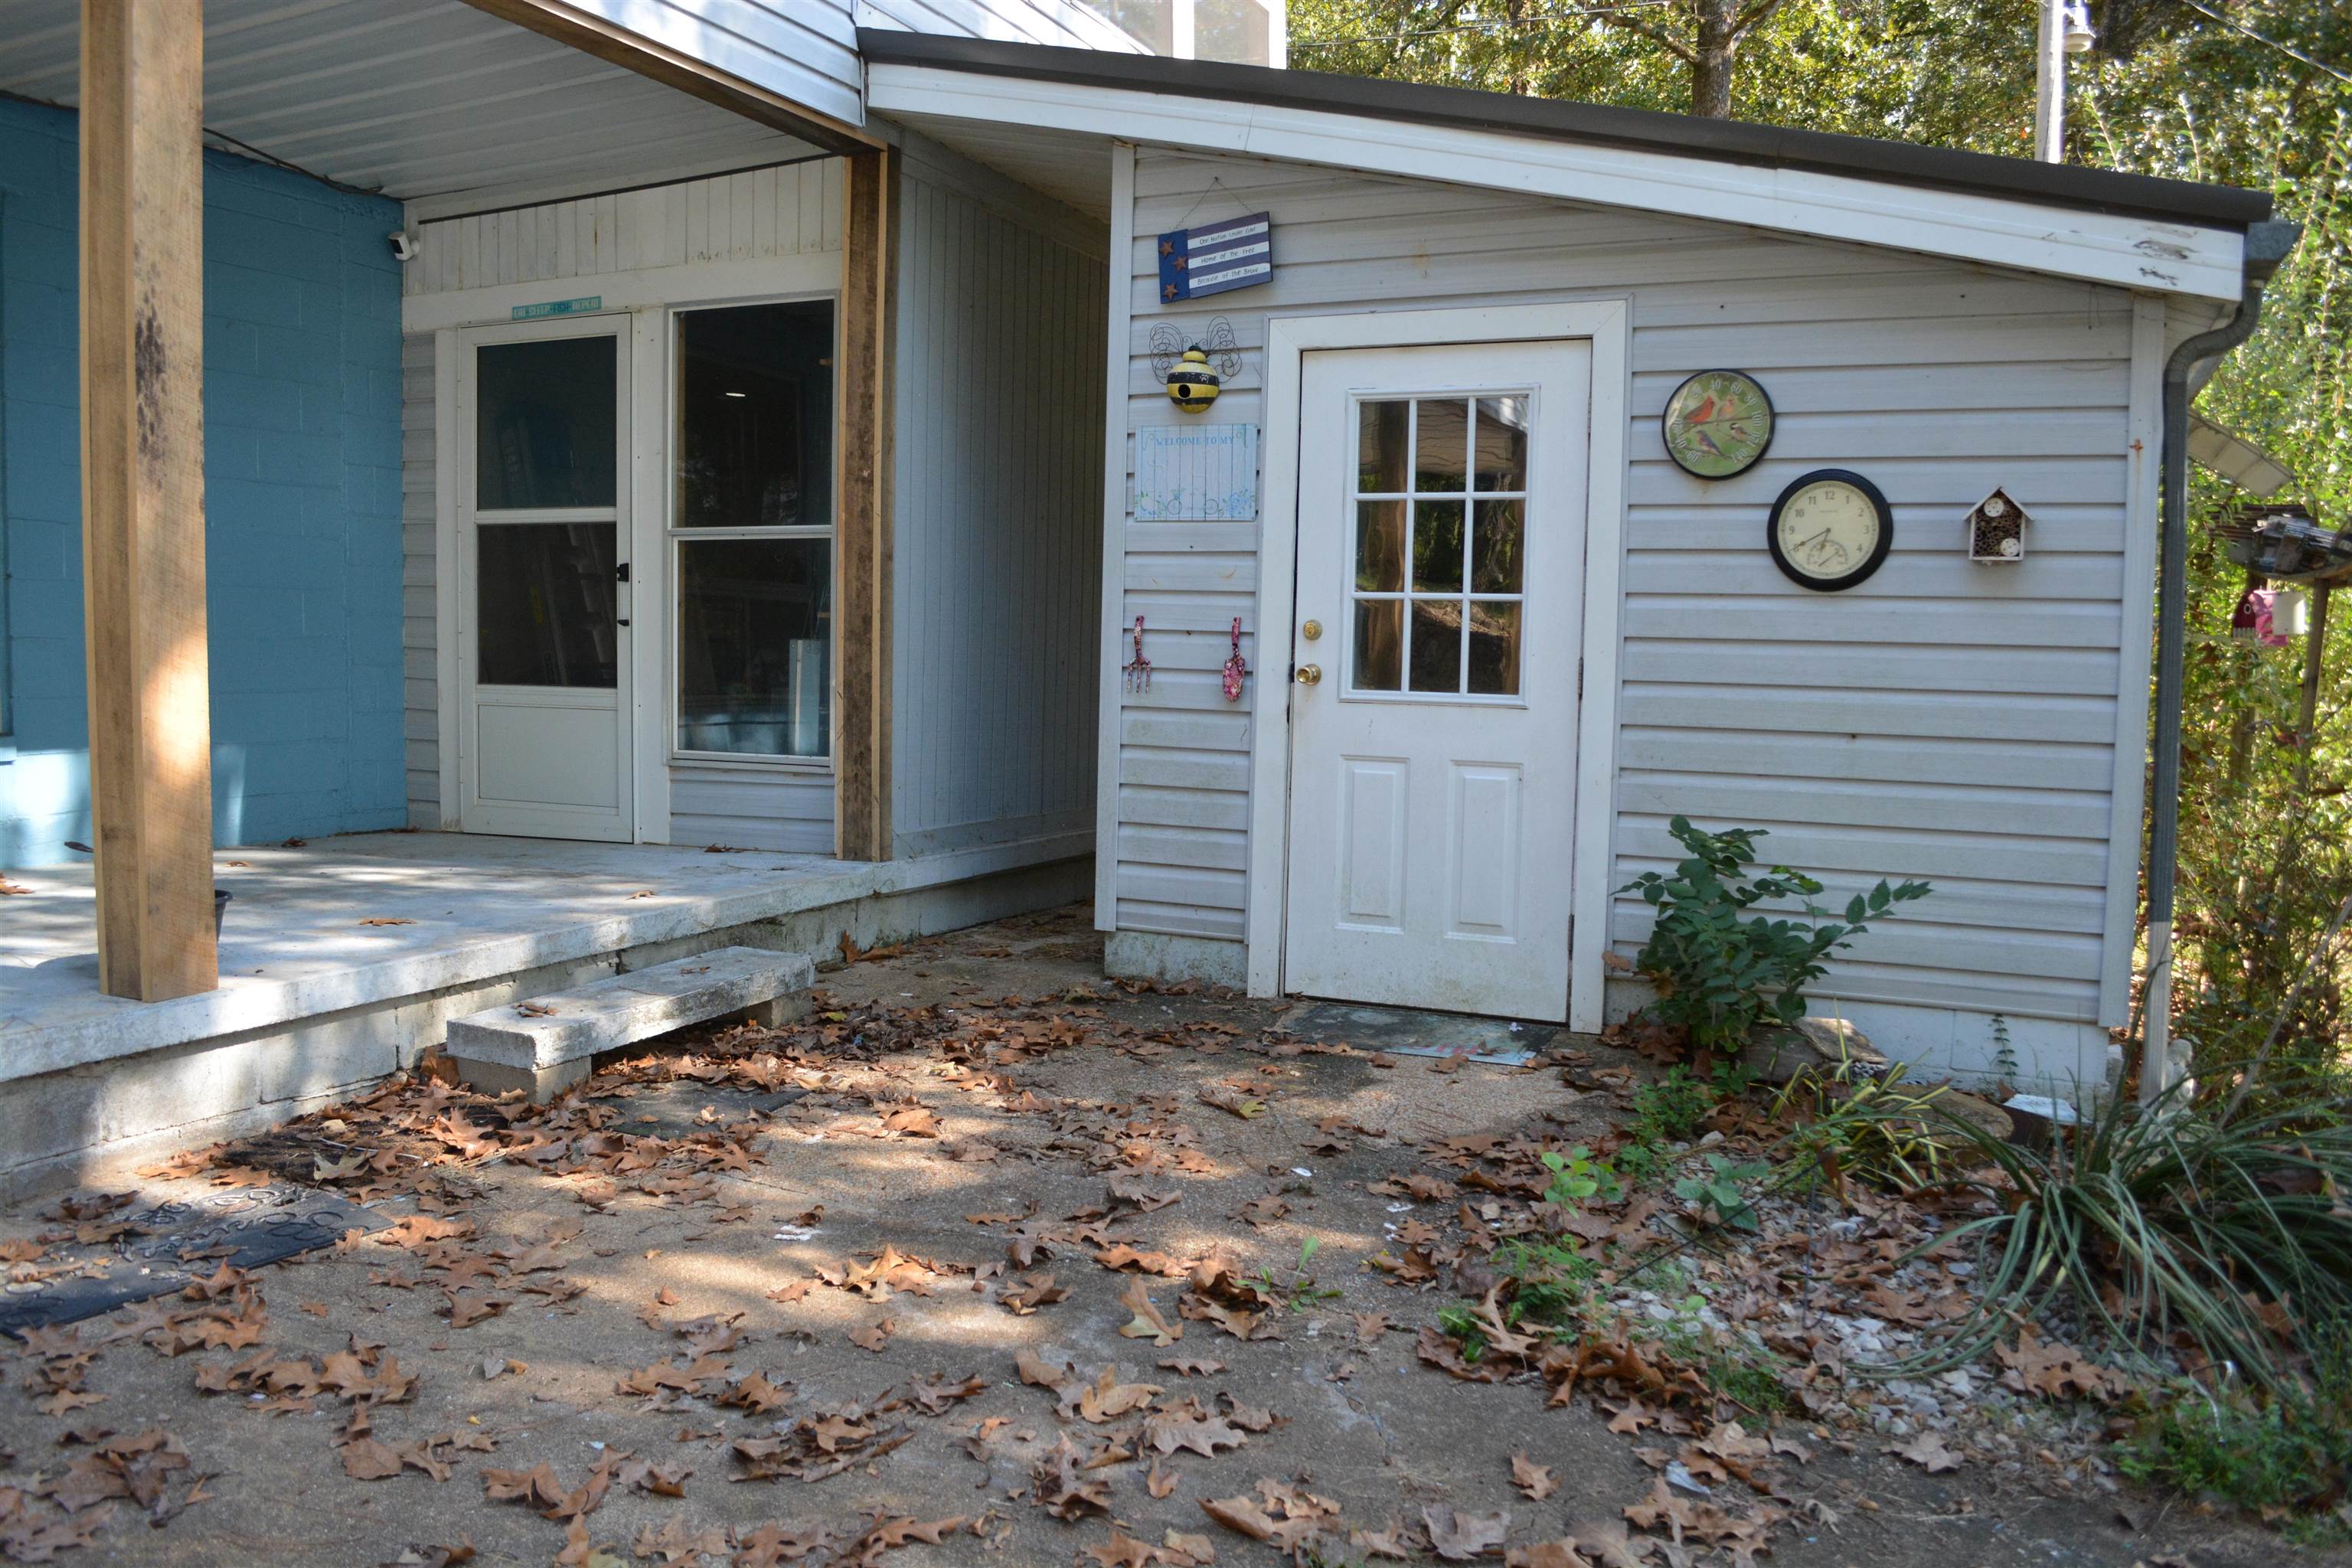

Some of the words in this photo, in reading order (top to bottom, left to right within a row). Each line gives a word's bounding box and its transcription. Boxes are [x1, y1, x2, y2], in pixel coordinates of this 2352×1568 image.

[1199, 237, 1209, 245] One
[1200, 256, 1217, 264] Home
[1197, 275, 1218, 285] Because
[1710, 379, 1721, 390] 40
[1730, 383, 1742, 394] 60
[1155, 436, 1202, 446] WELCOME
[1206, 436, 1217, 445] TO
[1220, 436, 1233, 445] MY
[1824, 491, 1835, 500] 12
[1808, 496, 1817, 505] 11
[1795, 508, 1805, 518] 10
[1858, 508, 1864, 517] 2
[1788, 526, 1795, 534] 9
[1864, 525, 1869, 534] 3
[1857, 544, 1863, 552] 4
